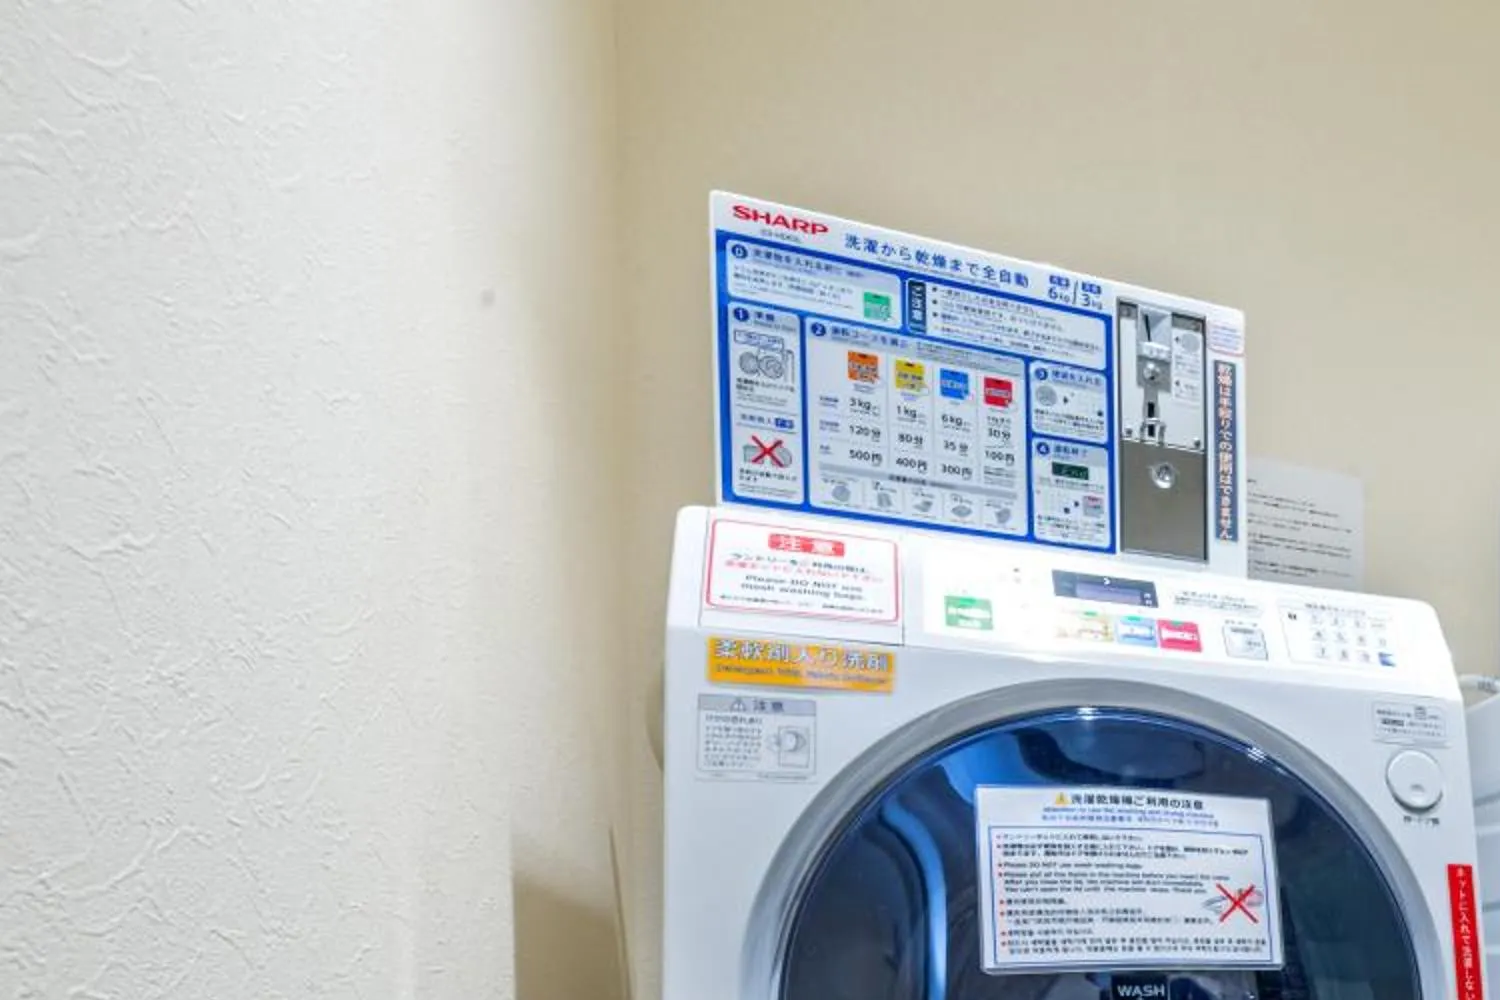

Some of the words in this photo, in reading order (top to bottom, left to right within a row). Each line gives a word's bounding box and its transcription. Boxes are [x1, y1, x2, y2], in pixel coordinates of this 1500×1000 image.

[732, 204, 829, 235] SHARP
[844, 233, 1029, 289] 洗濯から乾燥まで全自動
[1117, 983, 1166, 997] WASH
